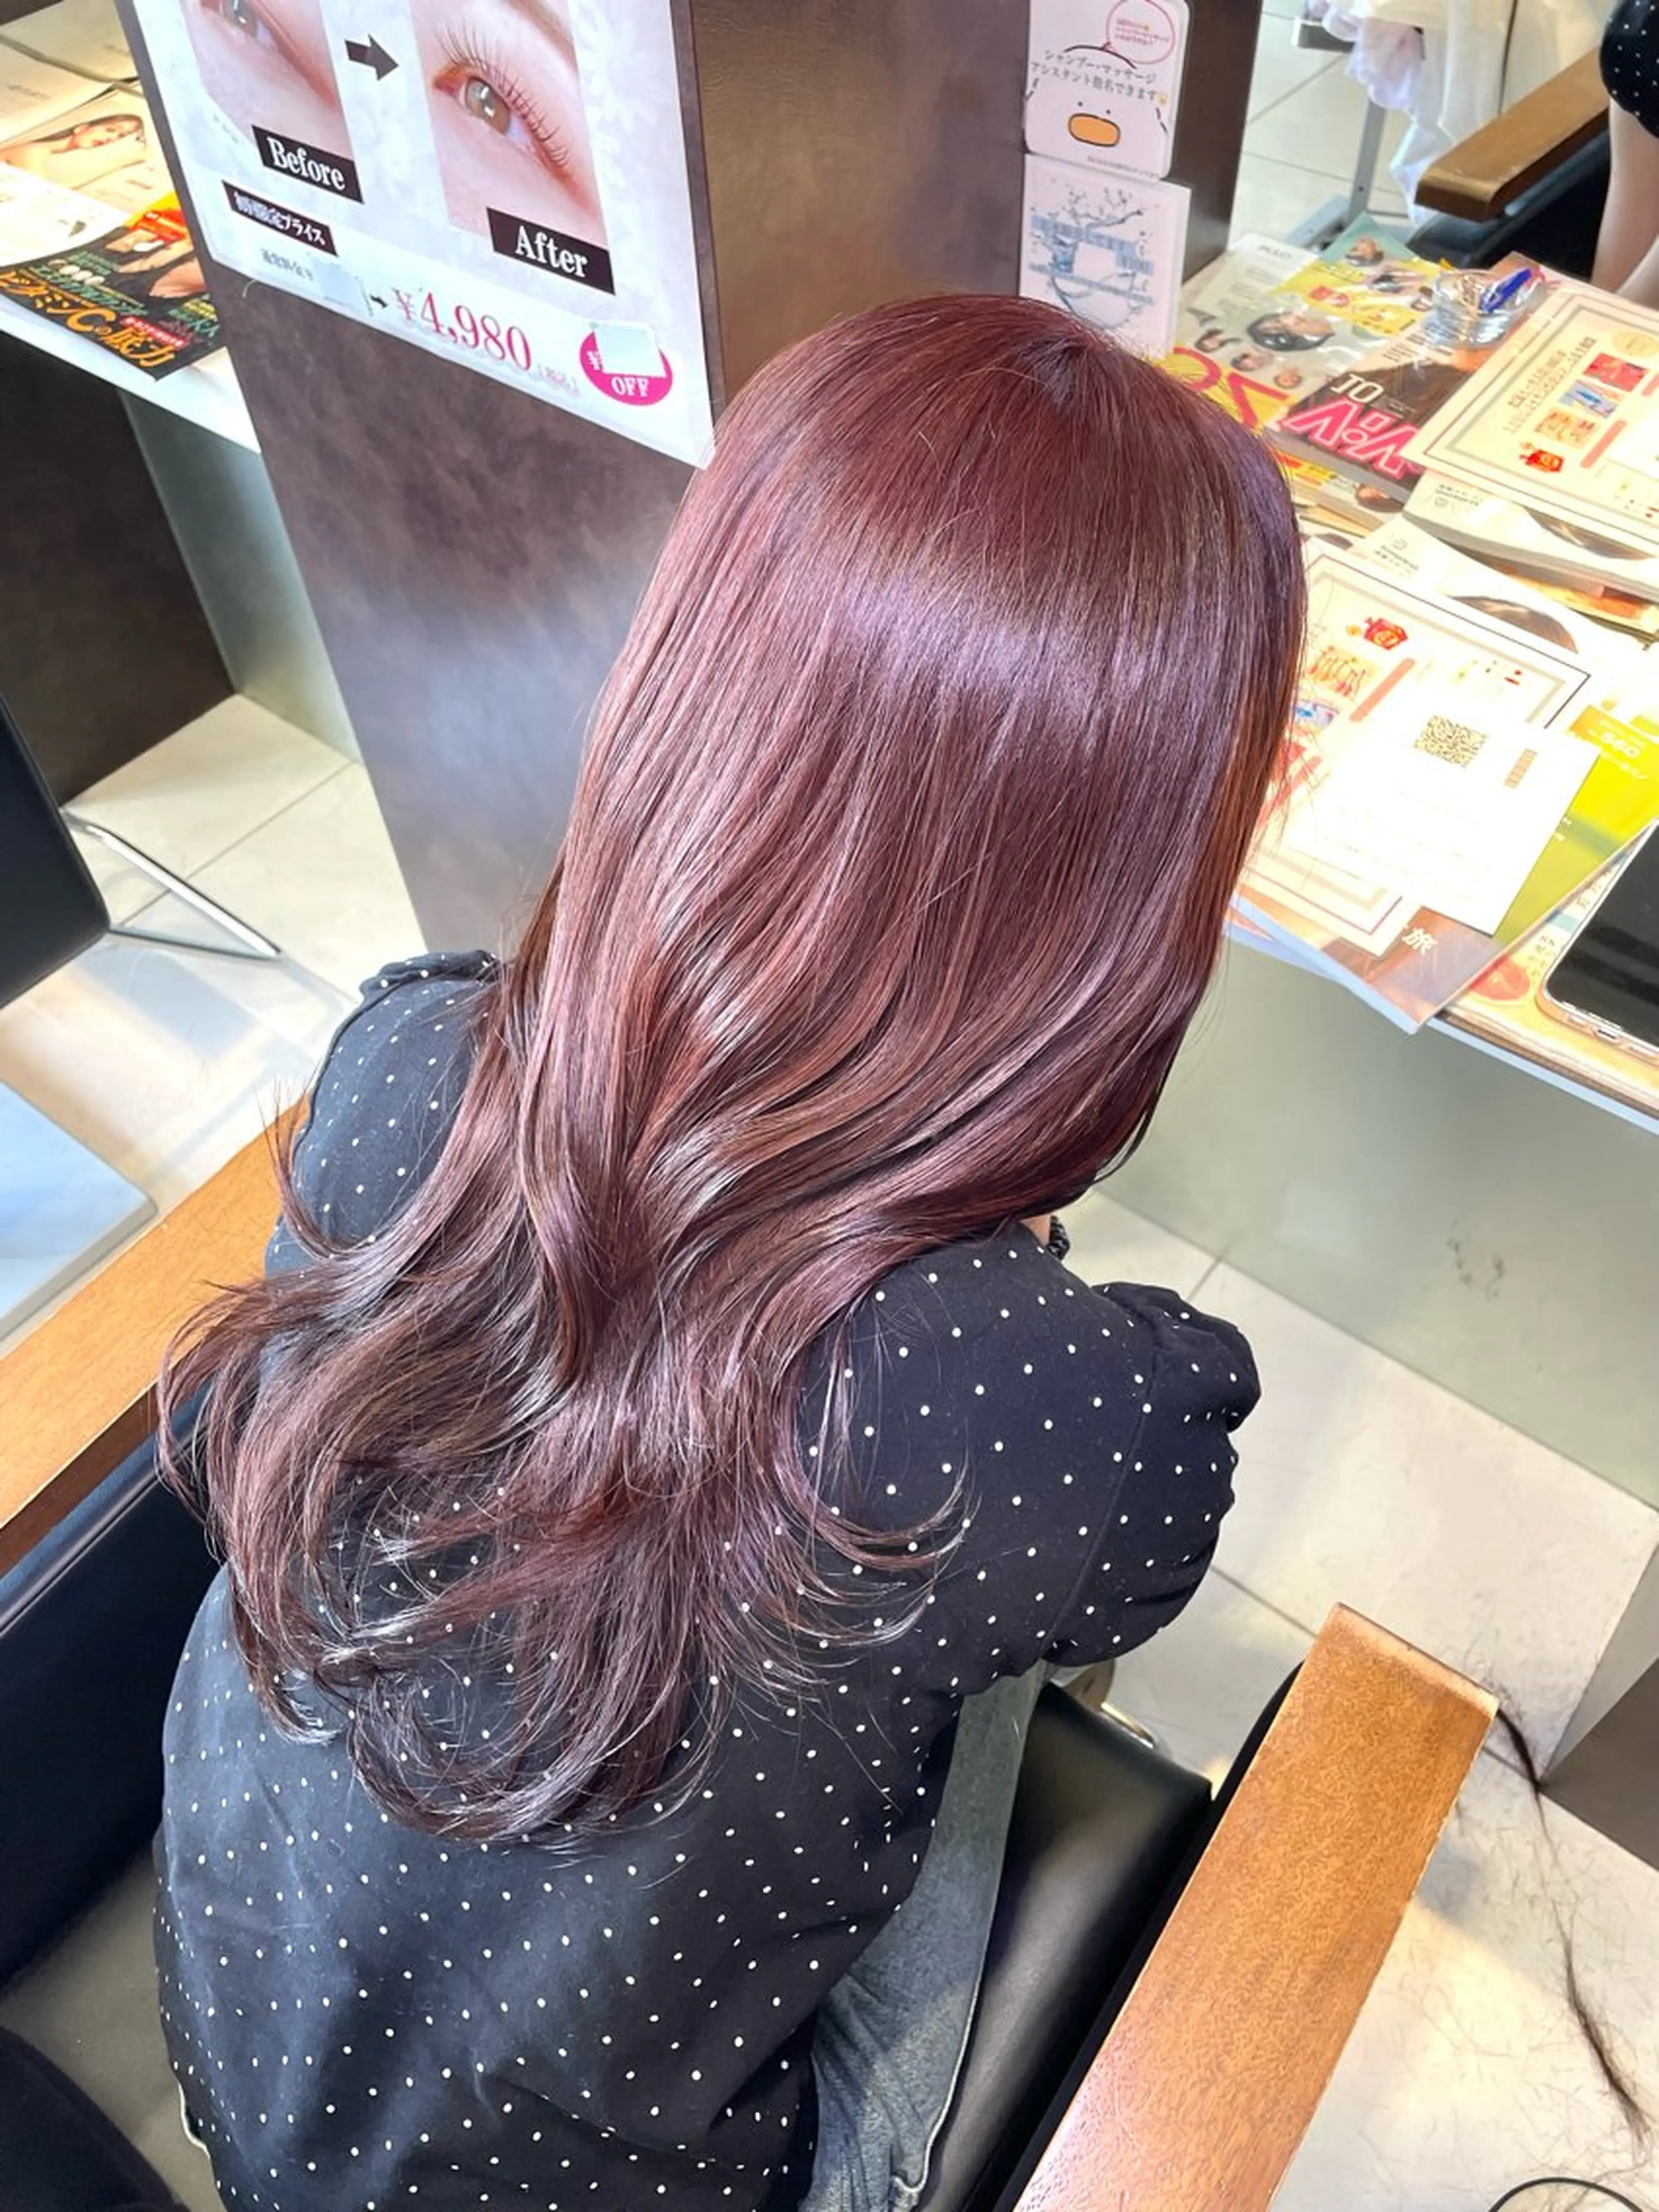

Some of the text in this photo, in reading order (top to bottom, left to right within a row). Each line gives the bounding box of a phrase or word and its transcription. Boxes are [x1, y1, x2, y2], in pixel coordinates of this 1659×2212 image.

[266, 136, 346, 191] Before
[515, 225, 588, 278] After
[610, 376, 649, 397] OFF
